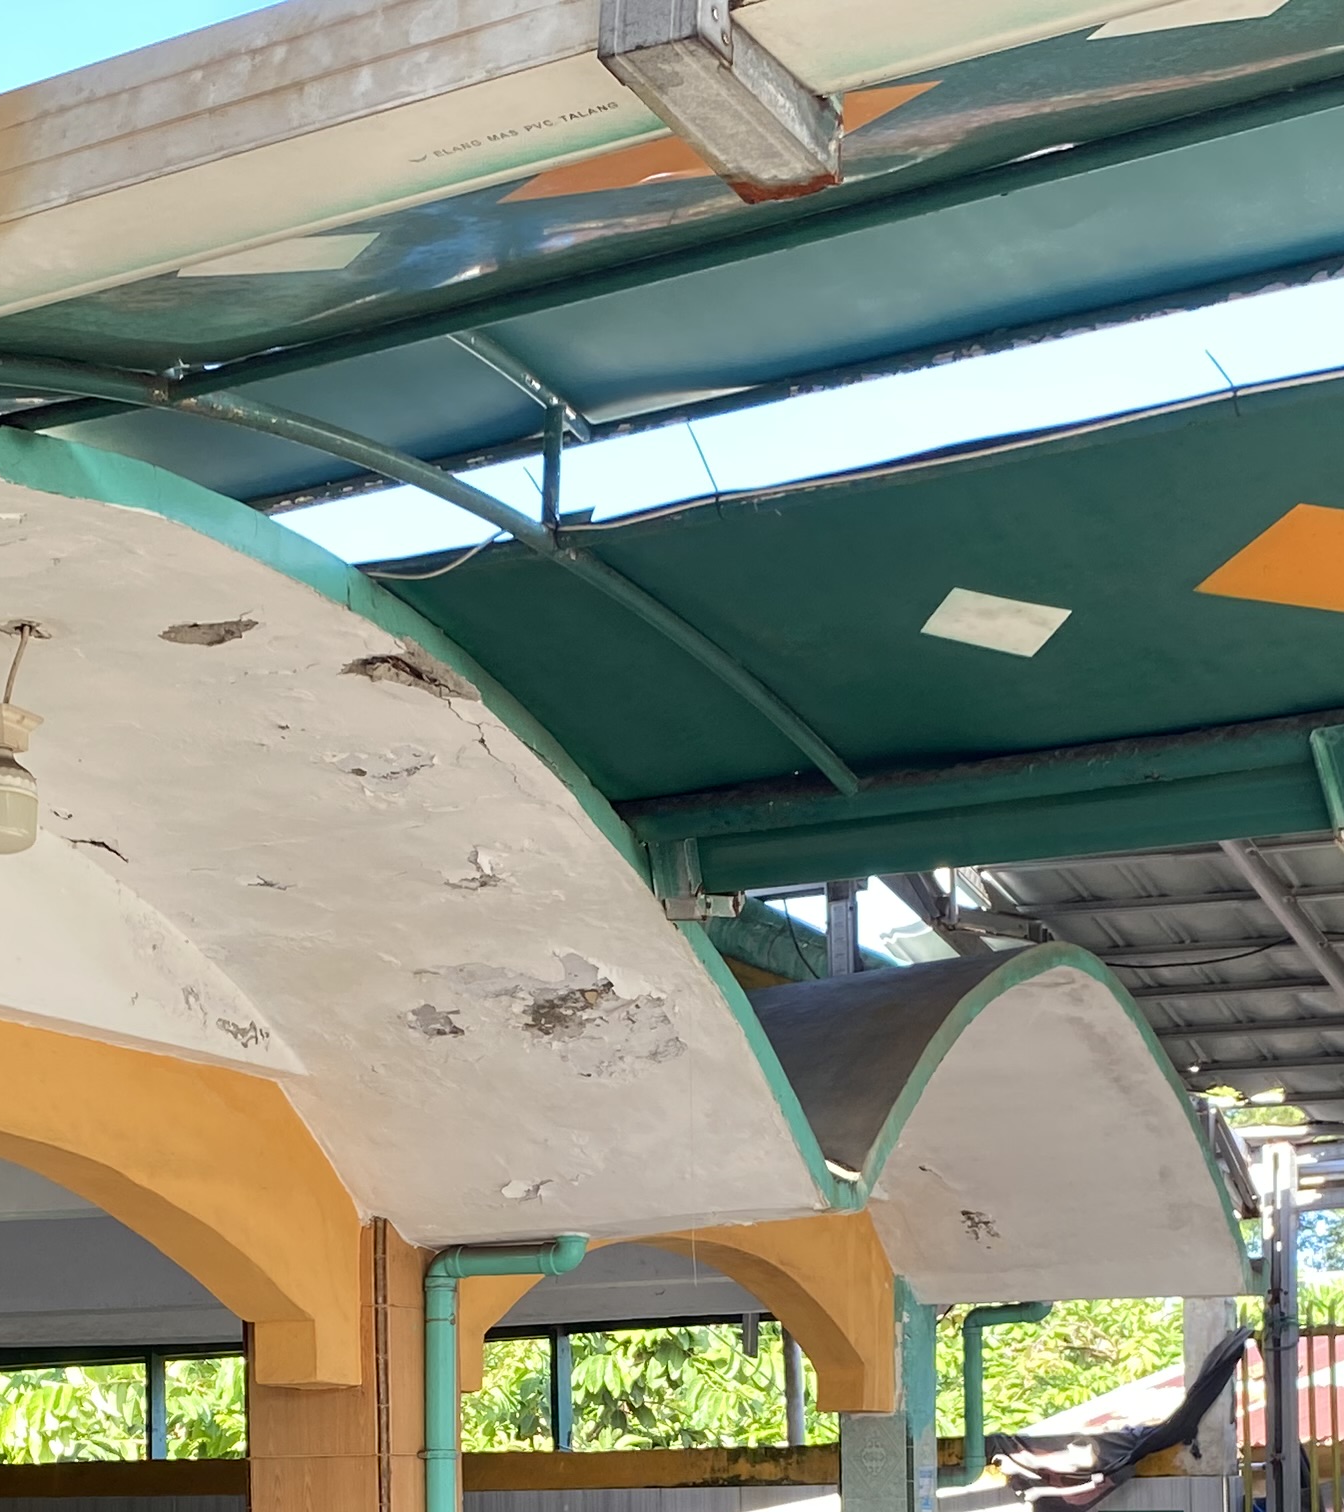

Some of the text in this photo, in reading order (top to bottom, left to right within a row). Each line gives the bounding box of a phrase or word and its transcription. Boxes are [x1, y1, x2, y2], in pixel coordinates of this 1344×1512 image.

[433, 101, 619, 158] ELANG MAS PVC TALANG
